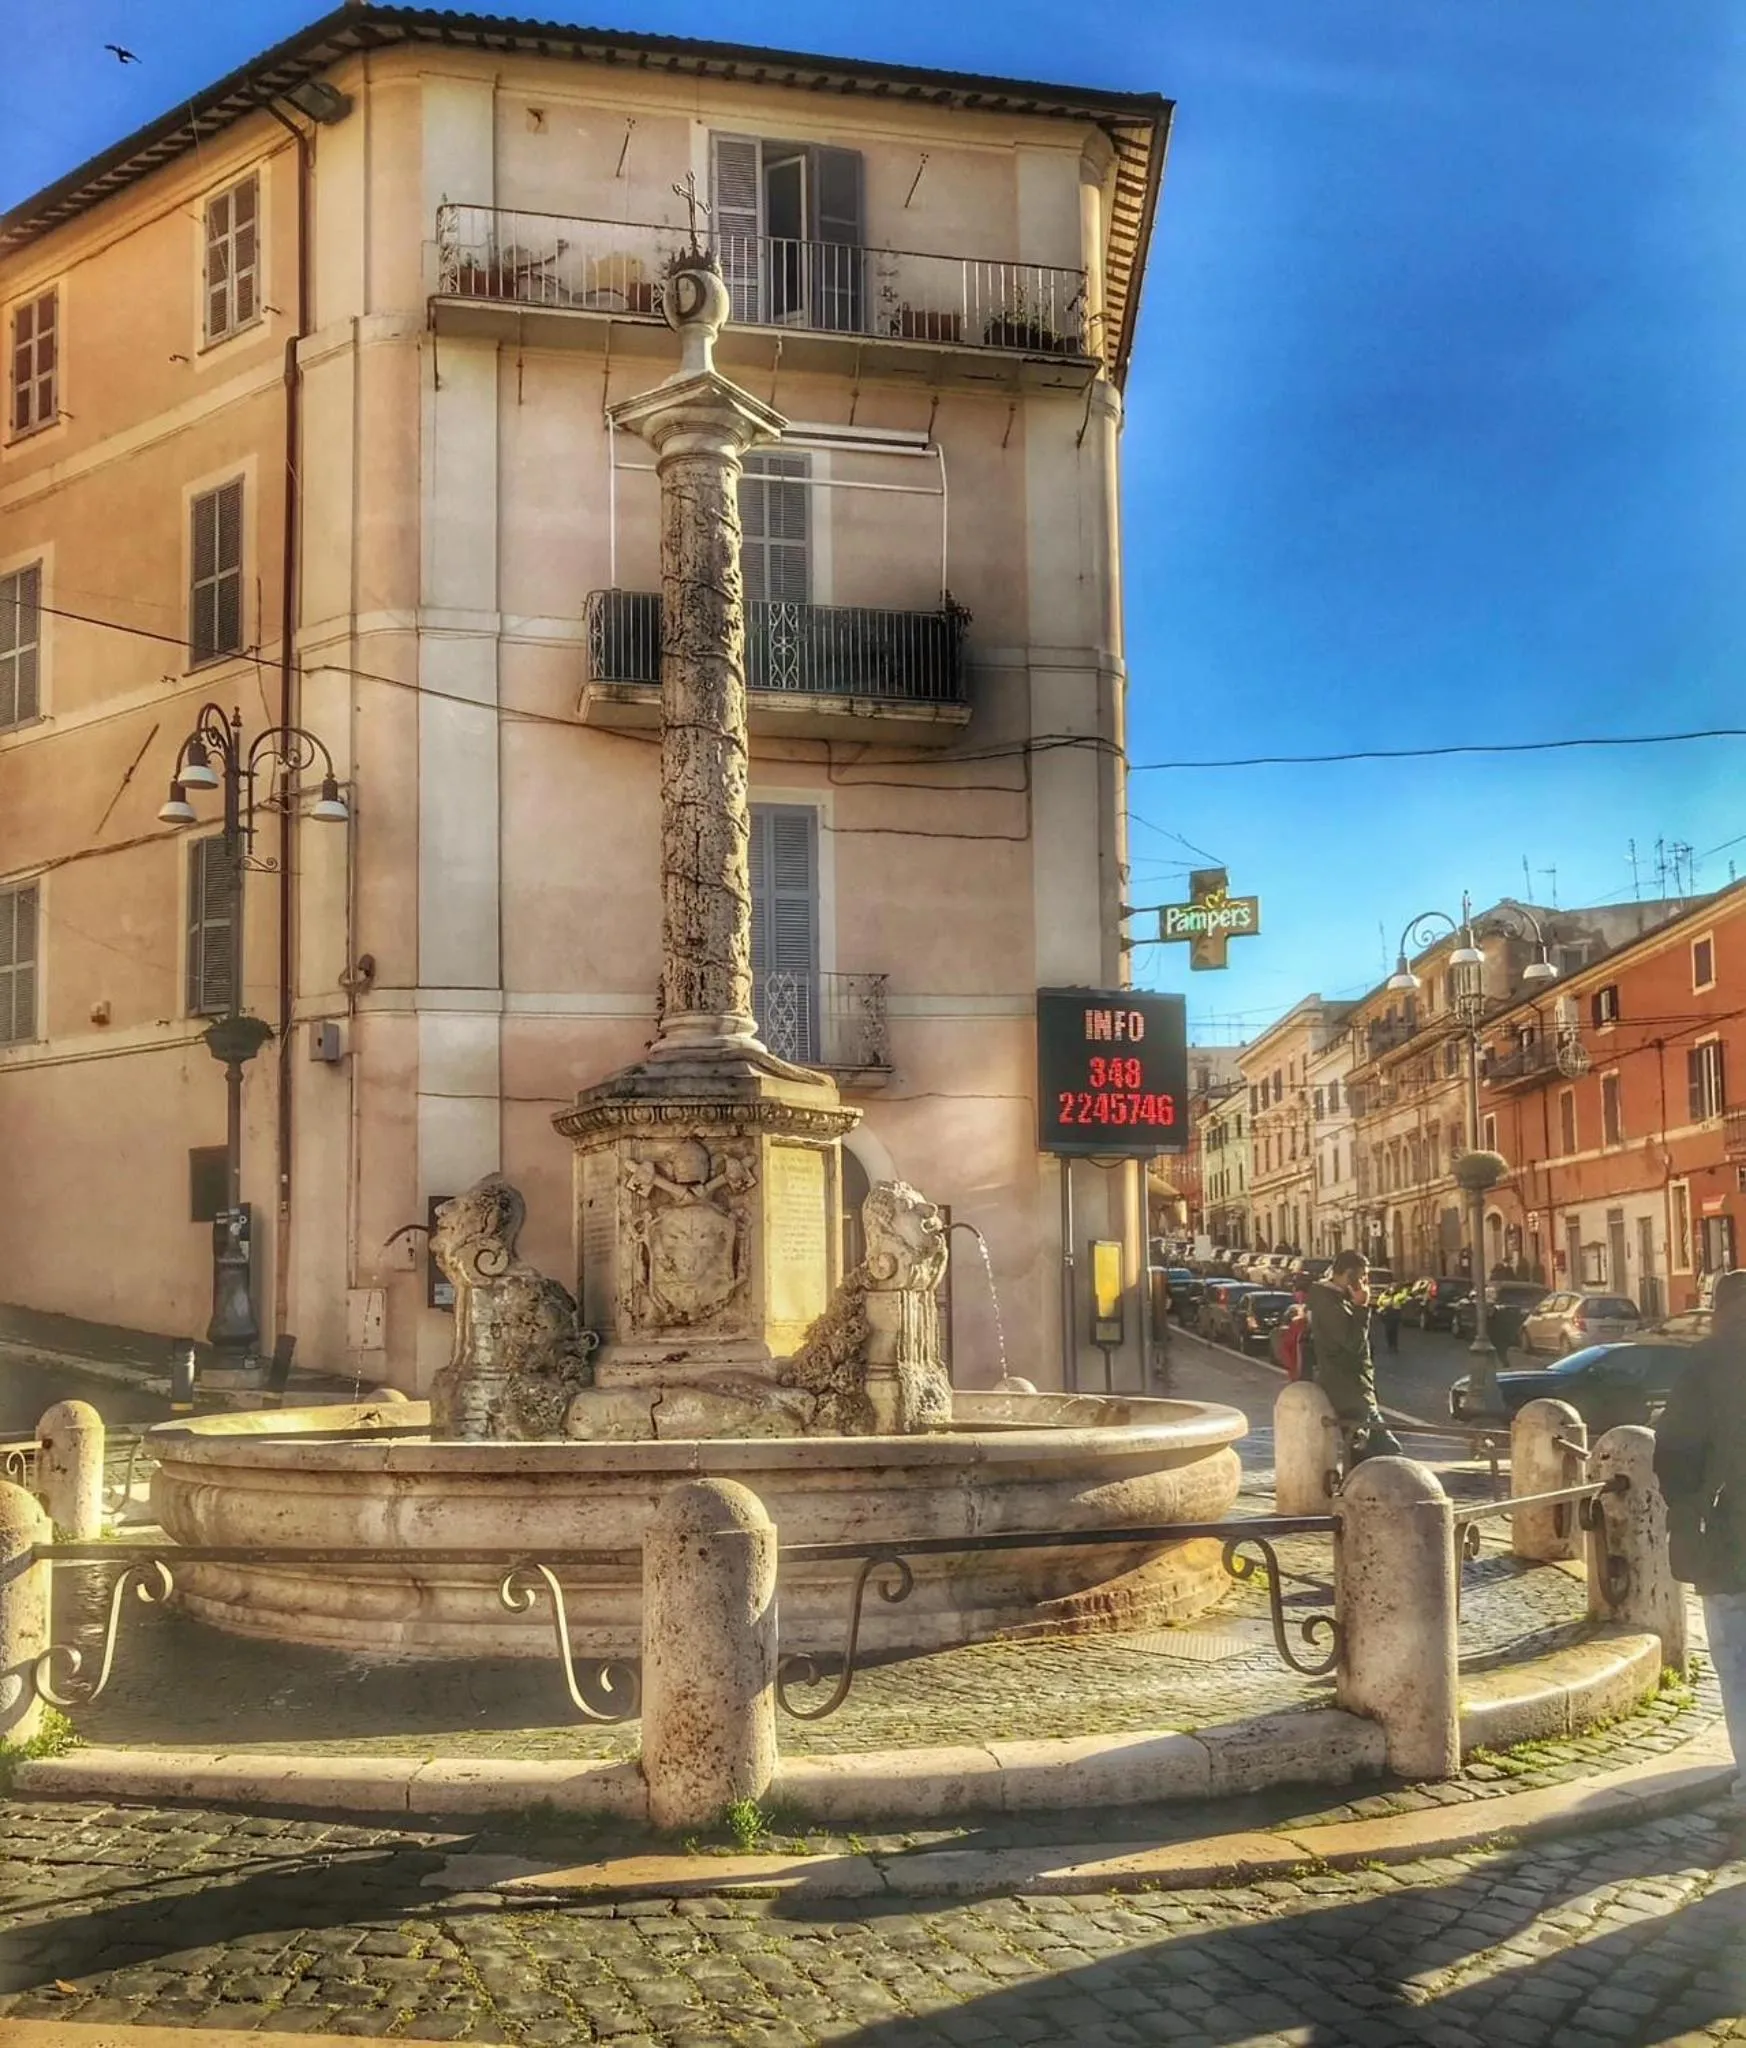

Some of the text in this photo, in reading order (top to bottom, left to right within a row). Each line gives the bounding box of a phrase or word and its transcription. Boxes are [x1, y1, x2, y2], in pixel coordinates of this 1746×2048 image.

[1166, 906, 1251, 937] Pampers
[1084, 1009, 1145, 1042] INFO
[1088, 1056, 1142, 1089] 348
[1058, 1092, 1175, 1126] 2245746
